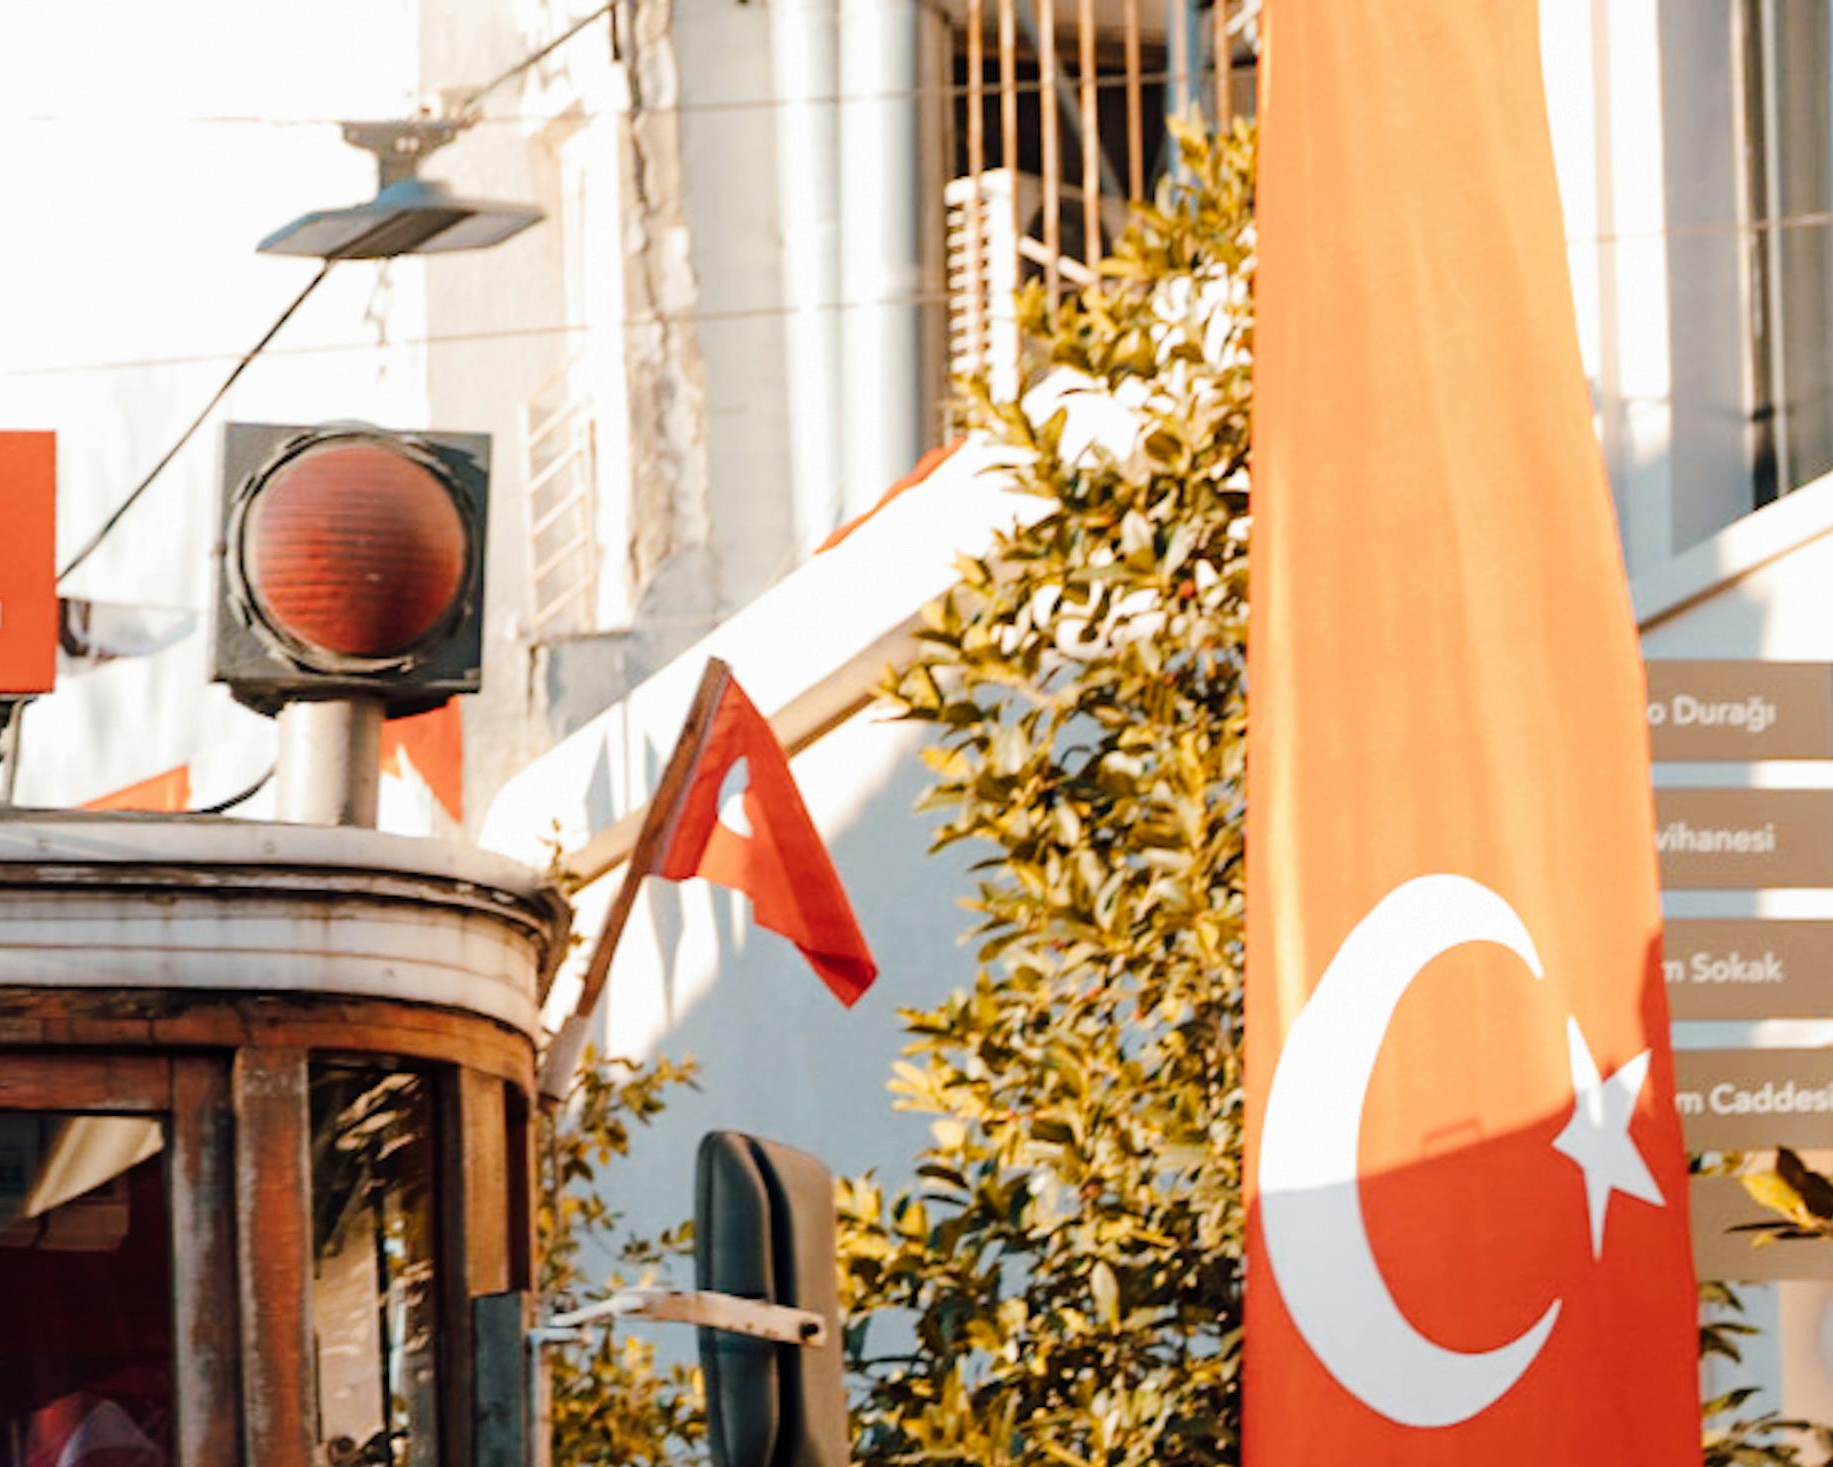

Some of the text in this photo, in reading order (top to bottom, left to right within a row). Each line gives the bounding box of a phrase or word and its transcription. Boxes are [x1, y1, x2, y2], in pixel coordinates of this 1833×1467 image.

[1673, 694, 1776, 733] Durağı
[1690, 952, 1784, 983] Sokak
[1709, 1081, 1833, 1115] Caddesi
